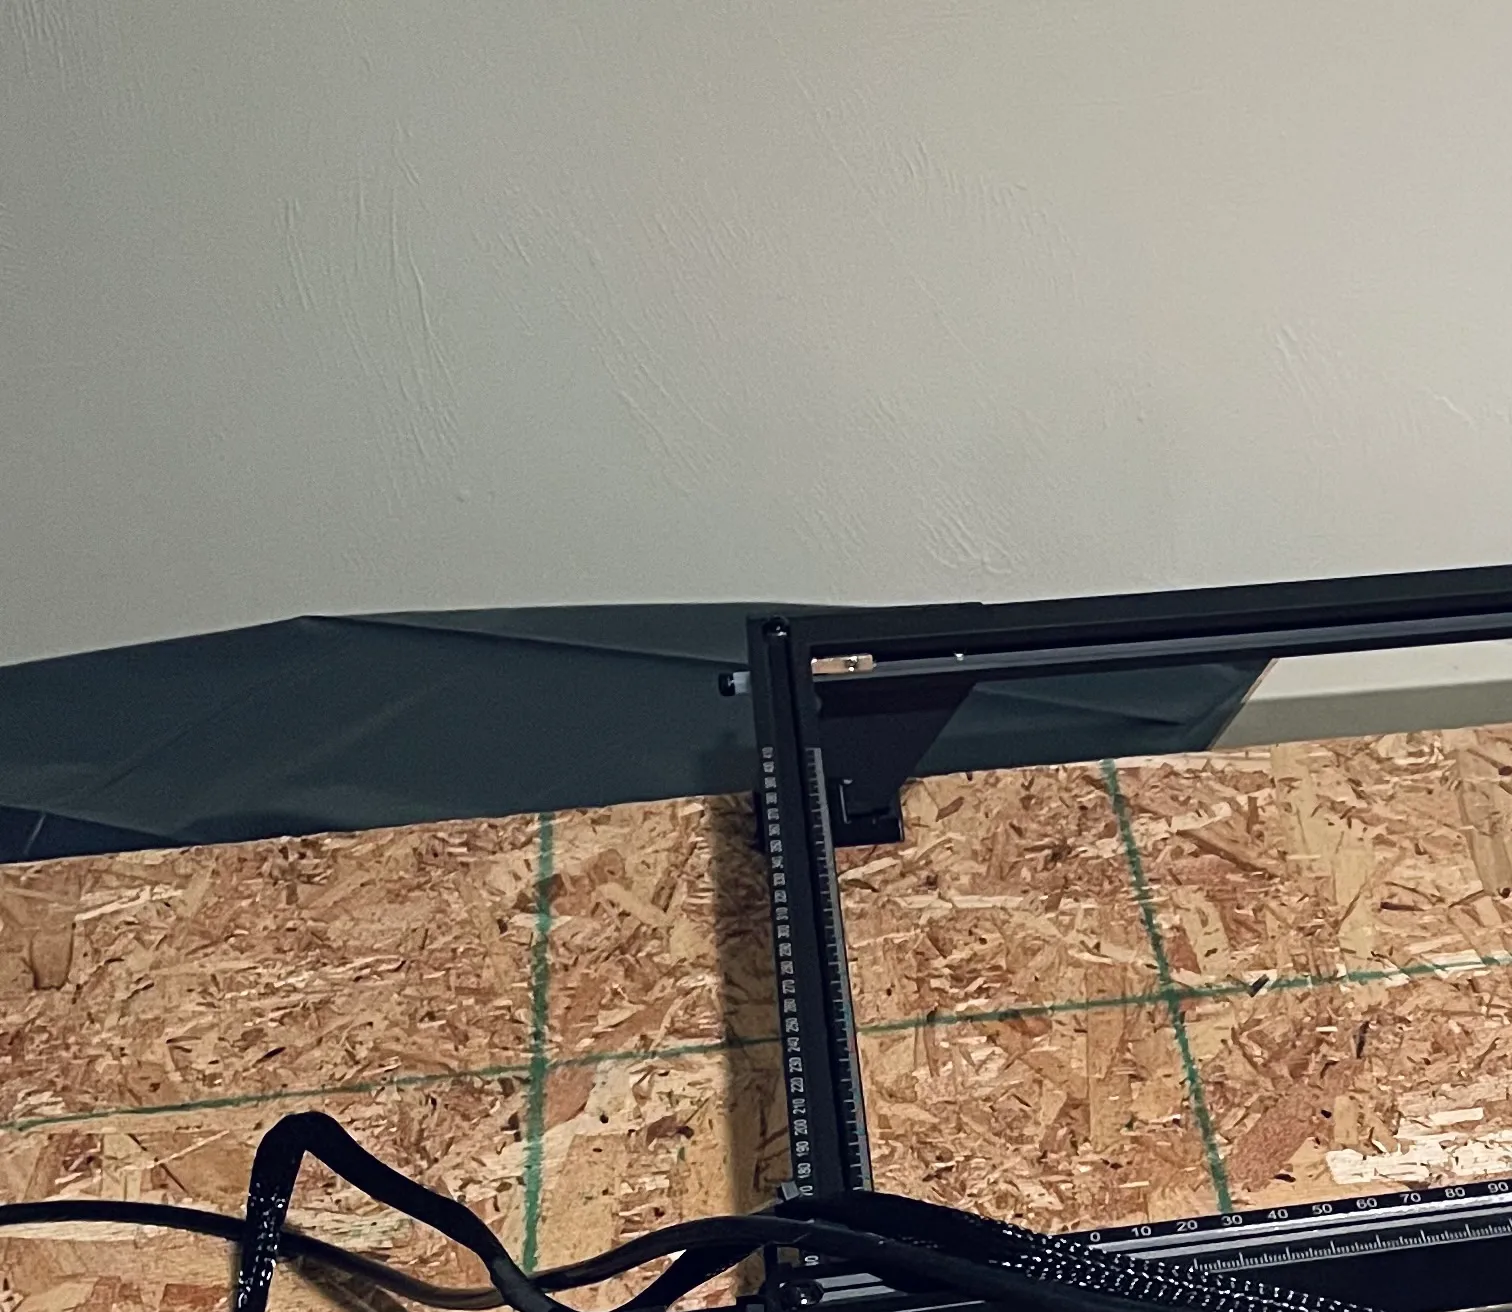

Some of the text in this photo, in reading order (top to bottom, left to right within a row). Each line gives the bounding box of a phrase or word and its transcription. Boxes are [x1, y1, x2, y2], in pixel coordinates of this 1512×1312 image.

[788, 1056, 802, 1072] 230
[790, 1077, 804, 1093] 220
[792, 1098, 806, 1114] 210
[793, 1119, 808, 1136] 200
[796, 1140, 809, 1157] 190
[798, 1162, 811, 1179] 180
[1089, 1232, 1101, 1243] 0
[1131, 1225, 1152, 1238] 10
[1176, 1219, 1199, 1233] 20
[1221, 1214, 1244, 1227] 30
[1267, 1208, 1289, 1221] 40
[1312, 1203, 1333, 1215] 50
[1356, 1197, 1378, 1210] 60
[1400, 1192, 1422, 1204] 70
[1444, 1186, 1466, 1199] 80
[1487, 1181, 1510, 1194] 90
